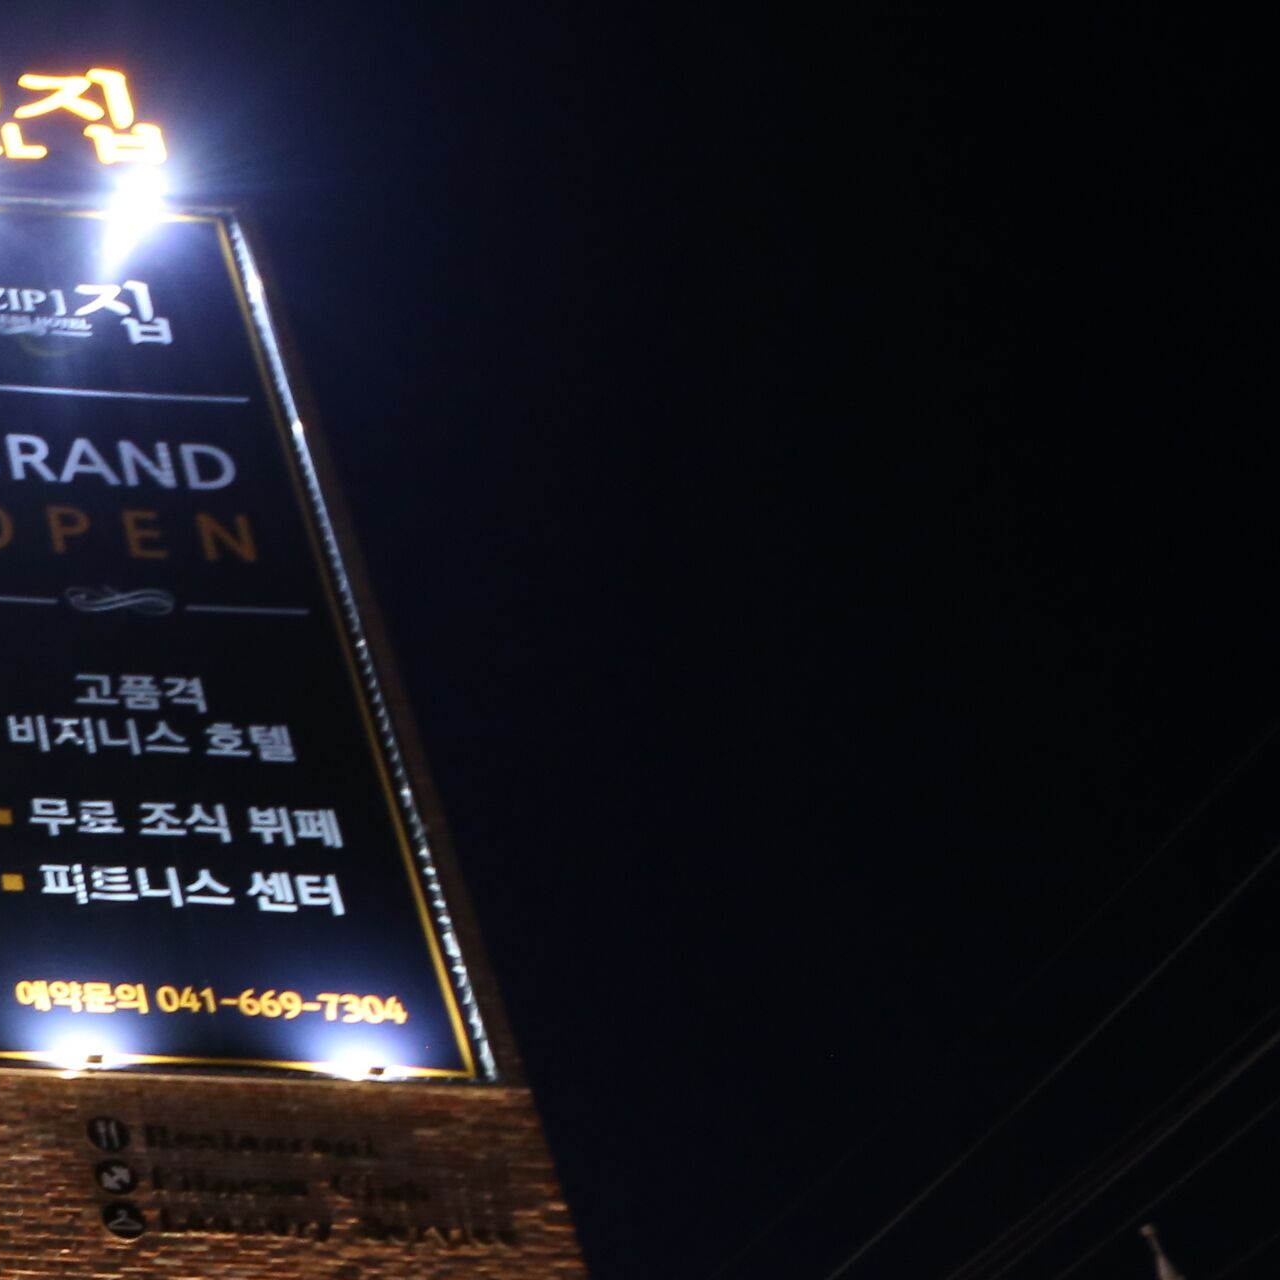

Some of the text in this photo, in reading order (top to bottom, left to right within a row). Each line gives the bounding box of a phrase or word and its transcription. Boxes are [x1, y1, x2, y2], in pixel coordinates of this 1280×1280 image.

[14, 68, 167, 165] 집
[74, 280, 173, 344] 집
[75, 674, 208, 713] 고품격
[7, 715, 297, 763] 비지니스 호텔
[29, 798, 343, 848] 무료 조식 뷔페
[39, 863, 345, 916] 피트니스 센터
[15, 980, 408, 1025] 예약문의 041-669-7304
